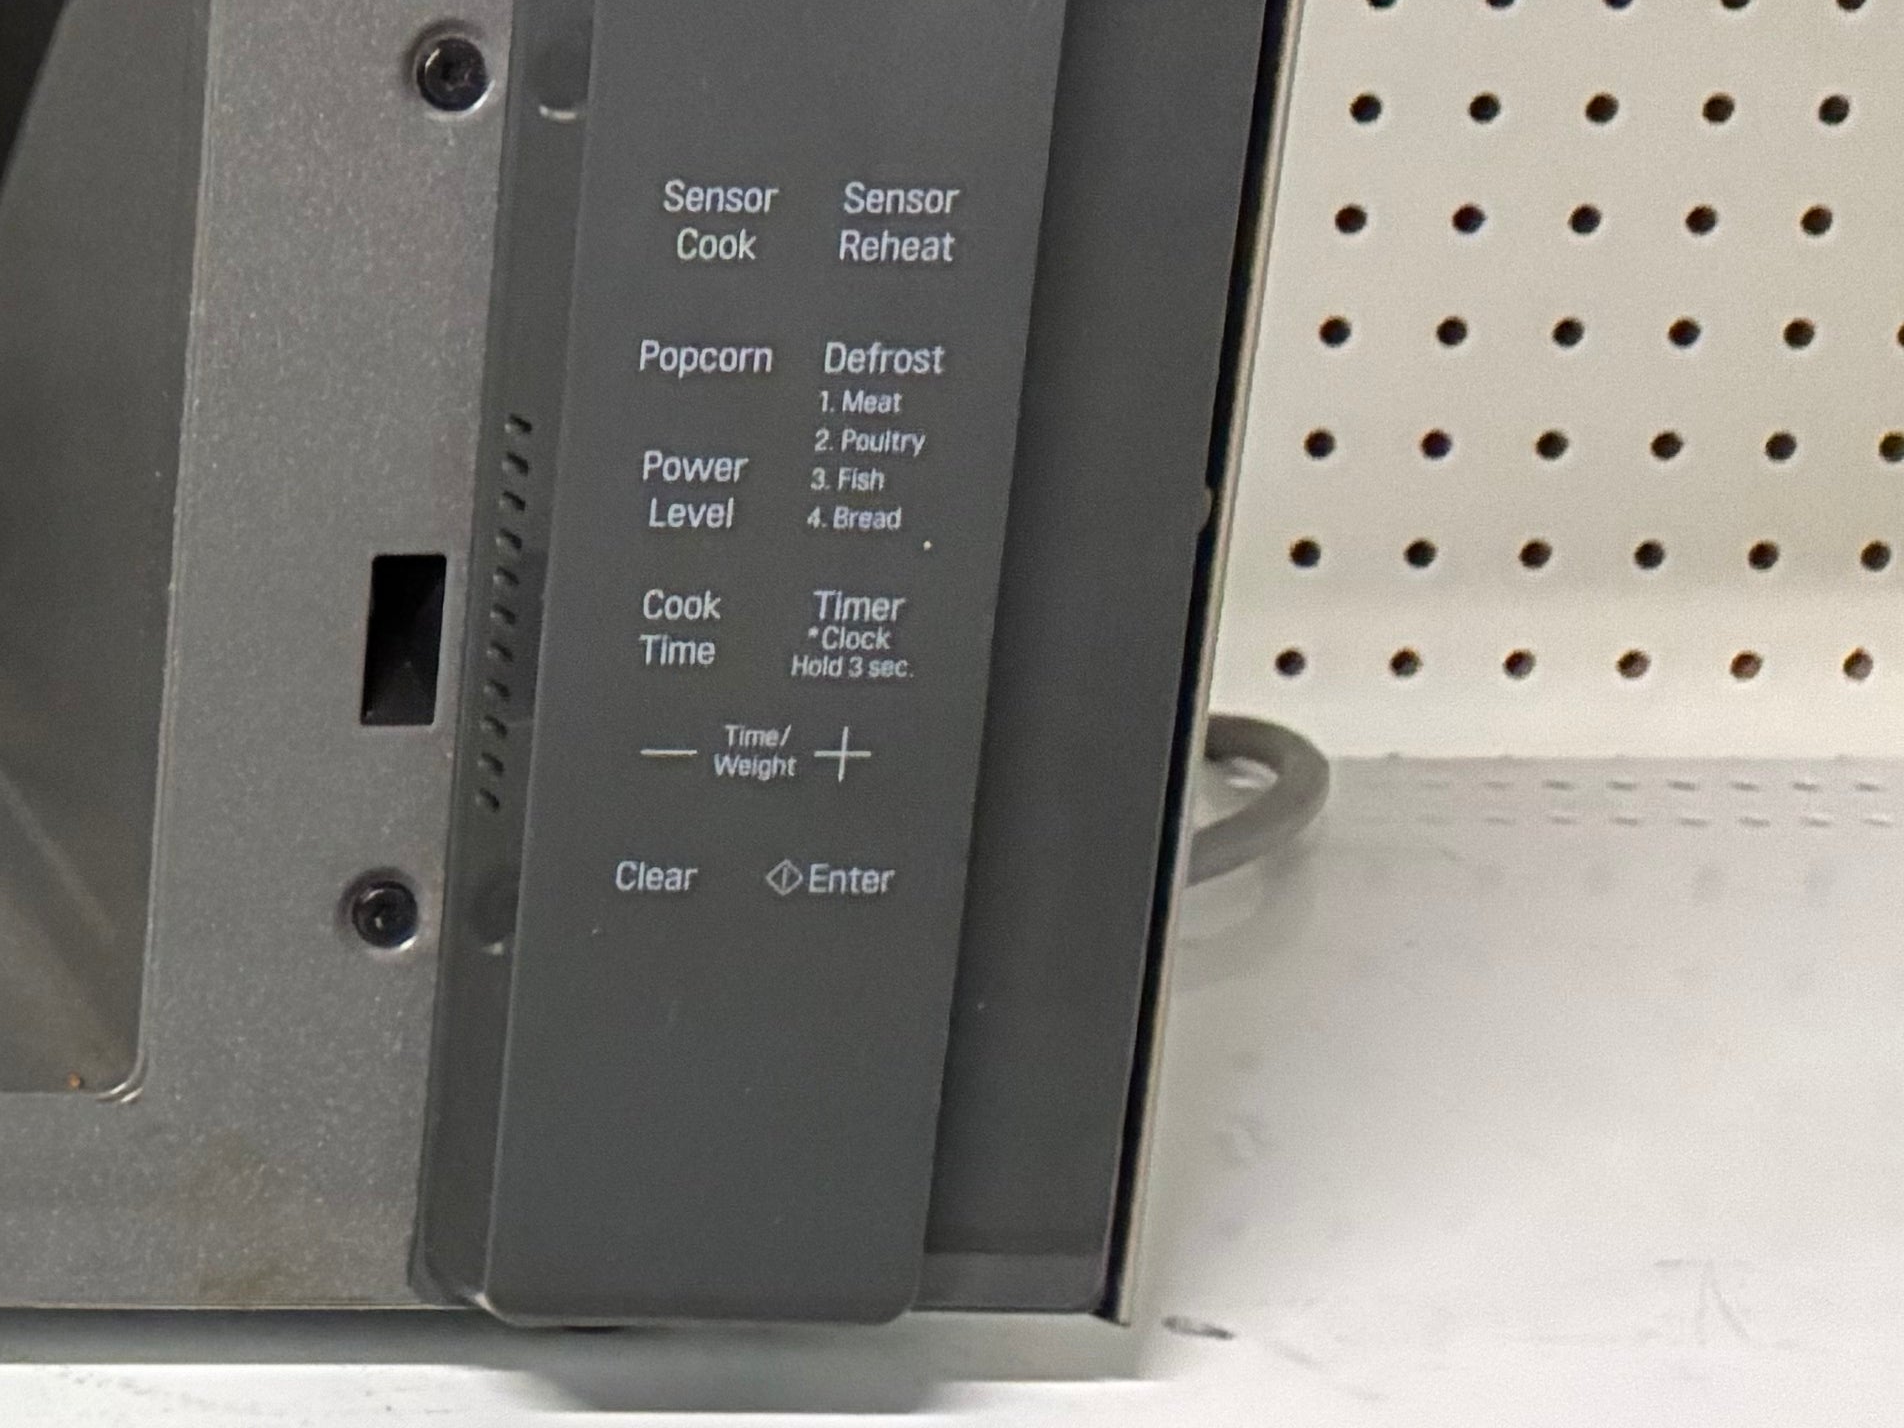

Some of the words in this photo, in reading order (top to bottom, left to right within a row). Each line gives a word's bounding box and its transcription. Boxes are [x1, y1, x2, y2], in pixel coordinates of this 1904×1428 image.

[663, 179, 780, 214] Sensor
[843, 181, 961, 214] Sensor
[676, 226, 757, 261] Cook
[839, 229, 956, 262] Reheat
[639, 339, 773, 379] Popcorn
[824, 341, 945, 375] Defrost
[820, 390, 835, 413] 1.
[841, 389, 903, 414] Meat
[814, 427, 834, 452] 2.
[841, 428, 926, 457] Poultry
[642, 449, 750, 483] Power
[810, 466, 831, 491] 3.
[837, 466, 885, 492] Fish
[648, 496, 735, 529] Level
[806, 506, 827, 529] 4.
[833, 505, 902, 530] Bread
[643, 588, 722, 621] Cook
[813, 589, 906, 622] Timer
[638, 633, 716, 666] Time
[790, 654, 844, 678] Hold
[848, 655, 864, 678] 3
[867, 659, 914, 679] sec.
[724, 724, 792, 748] Time/
[713, 753, 797, 782] Weight
[615, 860, 699, 891] Clear
[808, 863, 896, 894] Enter
